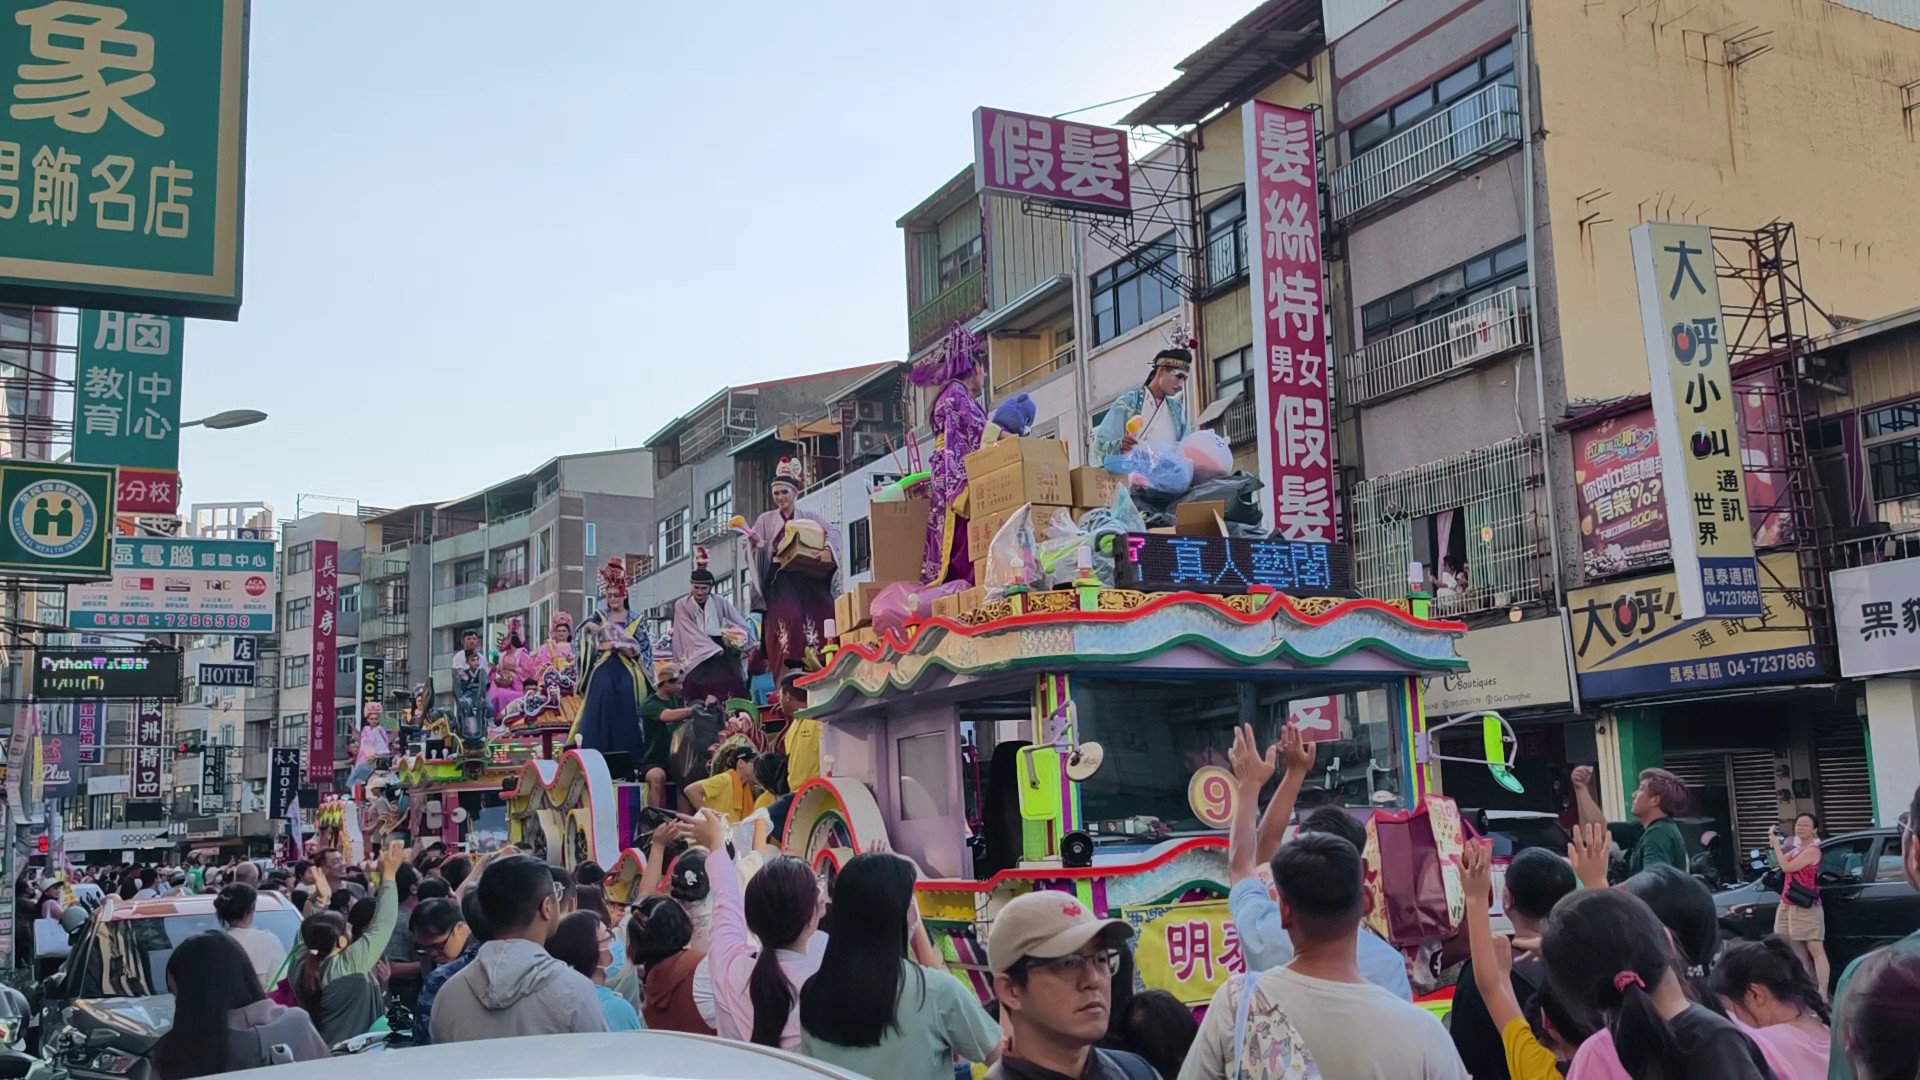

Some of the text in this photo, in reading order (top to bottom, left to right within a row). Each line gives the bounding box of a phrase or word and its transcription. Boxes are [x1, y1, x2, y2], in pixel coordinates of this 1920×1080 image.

[10, 0, 165, 137] 象
[989, 115, 1124, 201] 假髮
[1663, 239, 1731, 460] 大呼小叫
[84, 366, 124, 436] 教育
[133, 372, 172, 440] 中心
[1694, 492, 1718, 545] 世界
[1717, 469, 1744, 522] 通訊
[1705, 591, 1759, 606] 04-7237866
[201, 667, 253, 685] HOTEL
[235, 640, 252, 659] 店
[1727, 650, 1816, 677] 04-7237866
[1458, 677, 1497, 691] Boutiques
[1202, 775, 1233, 823] 9
